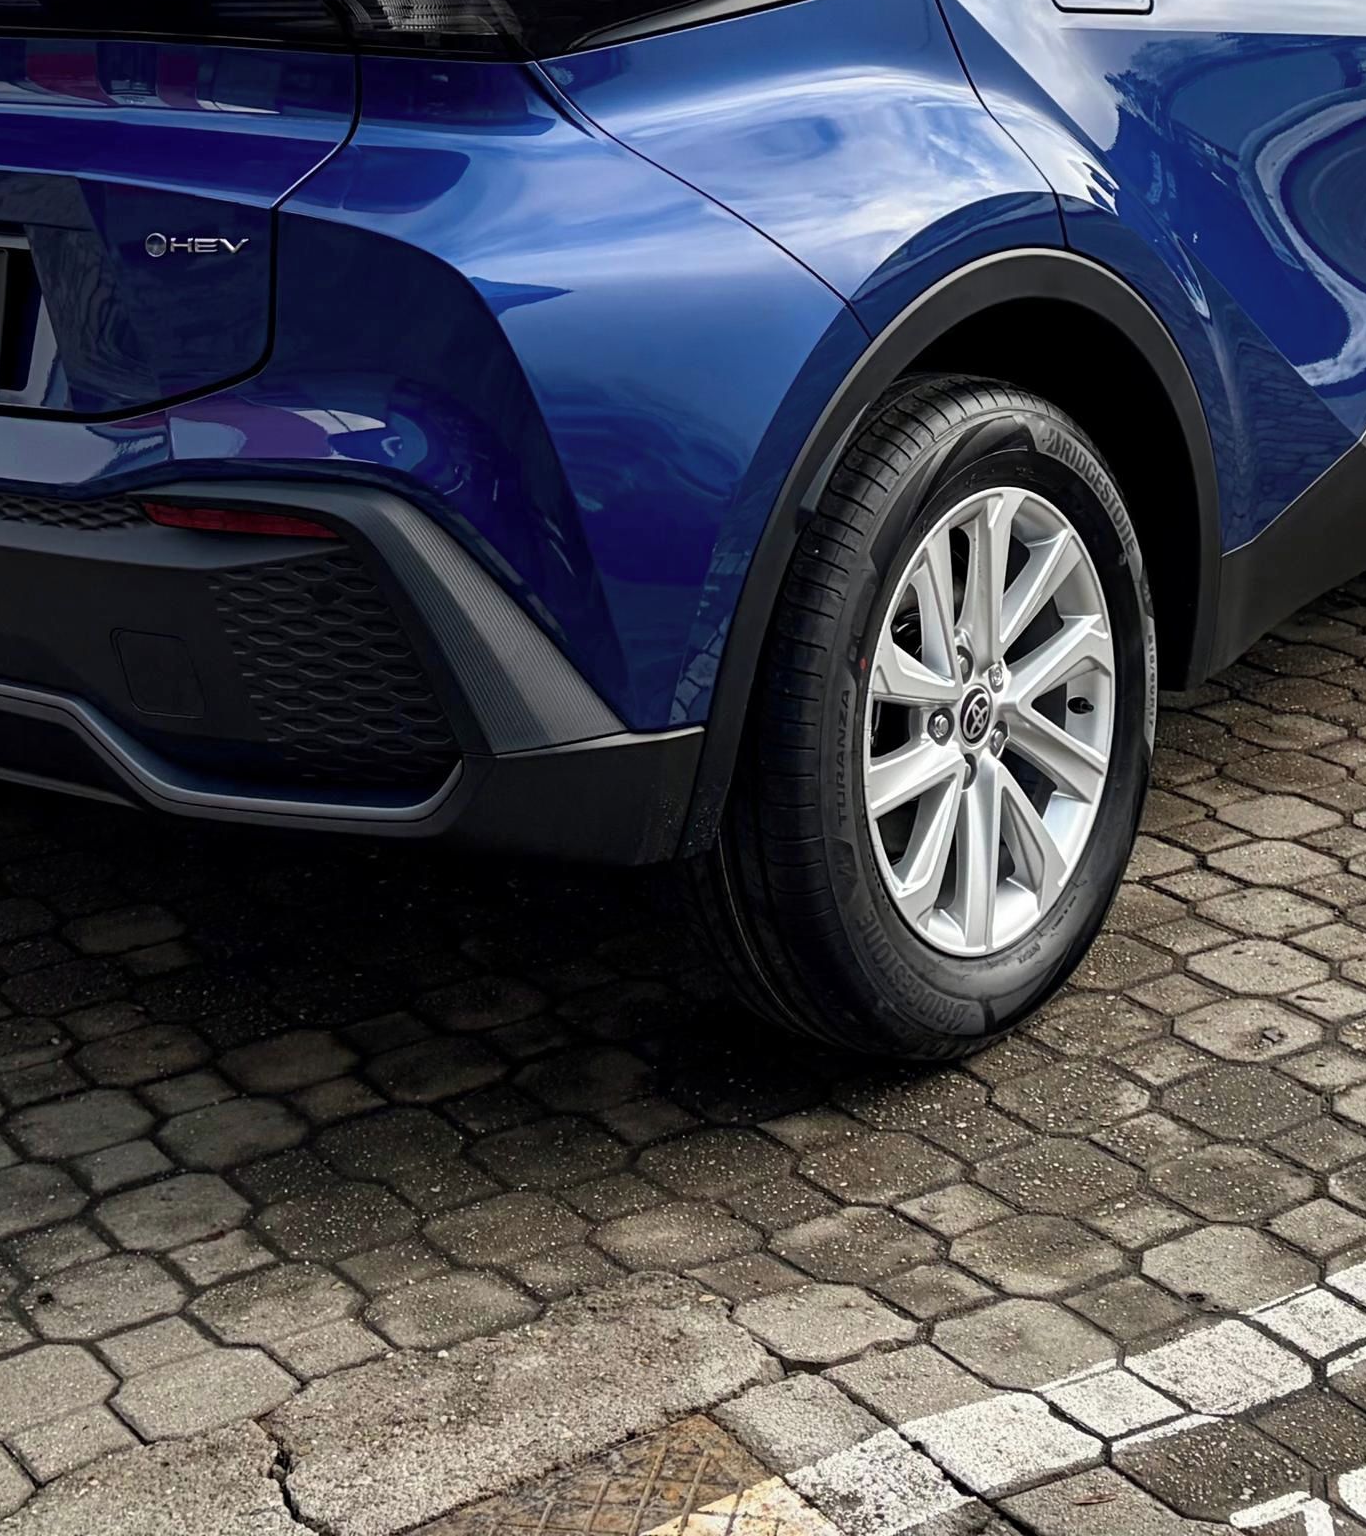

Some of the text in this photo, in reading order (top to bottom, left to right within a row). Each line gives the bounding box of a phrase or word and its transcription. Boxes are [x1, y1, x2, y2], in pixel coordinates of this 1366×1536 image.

[170, 237, 250, 253] HEV
[1042, 427, 1137, 557] BRIDGESTONE
[835, 688, 851, 829] TURANZA
[857, 910, 969, 1033] BRIDGESTONE
